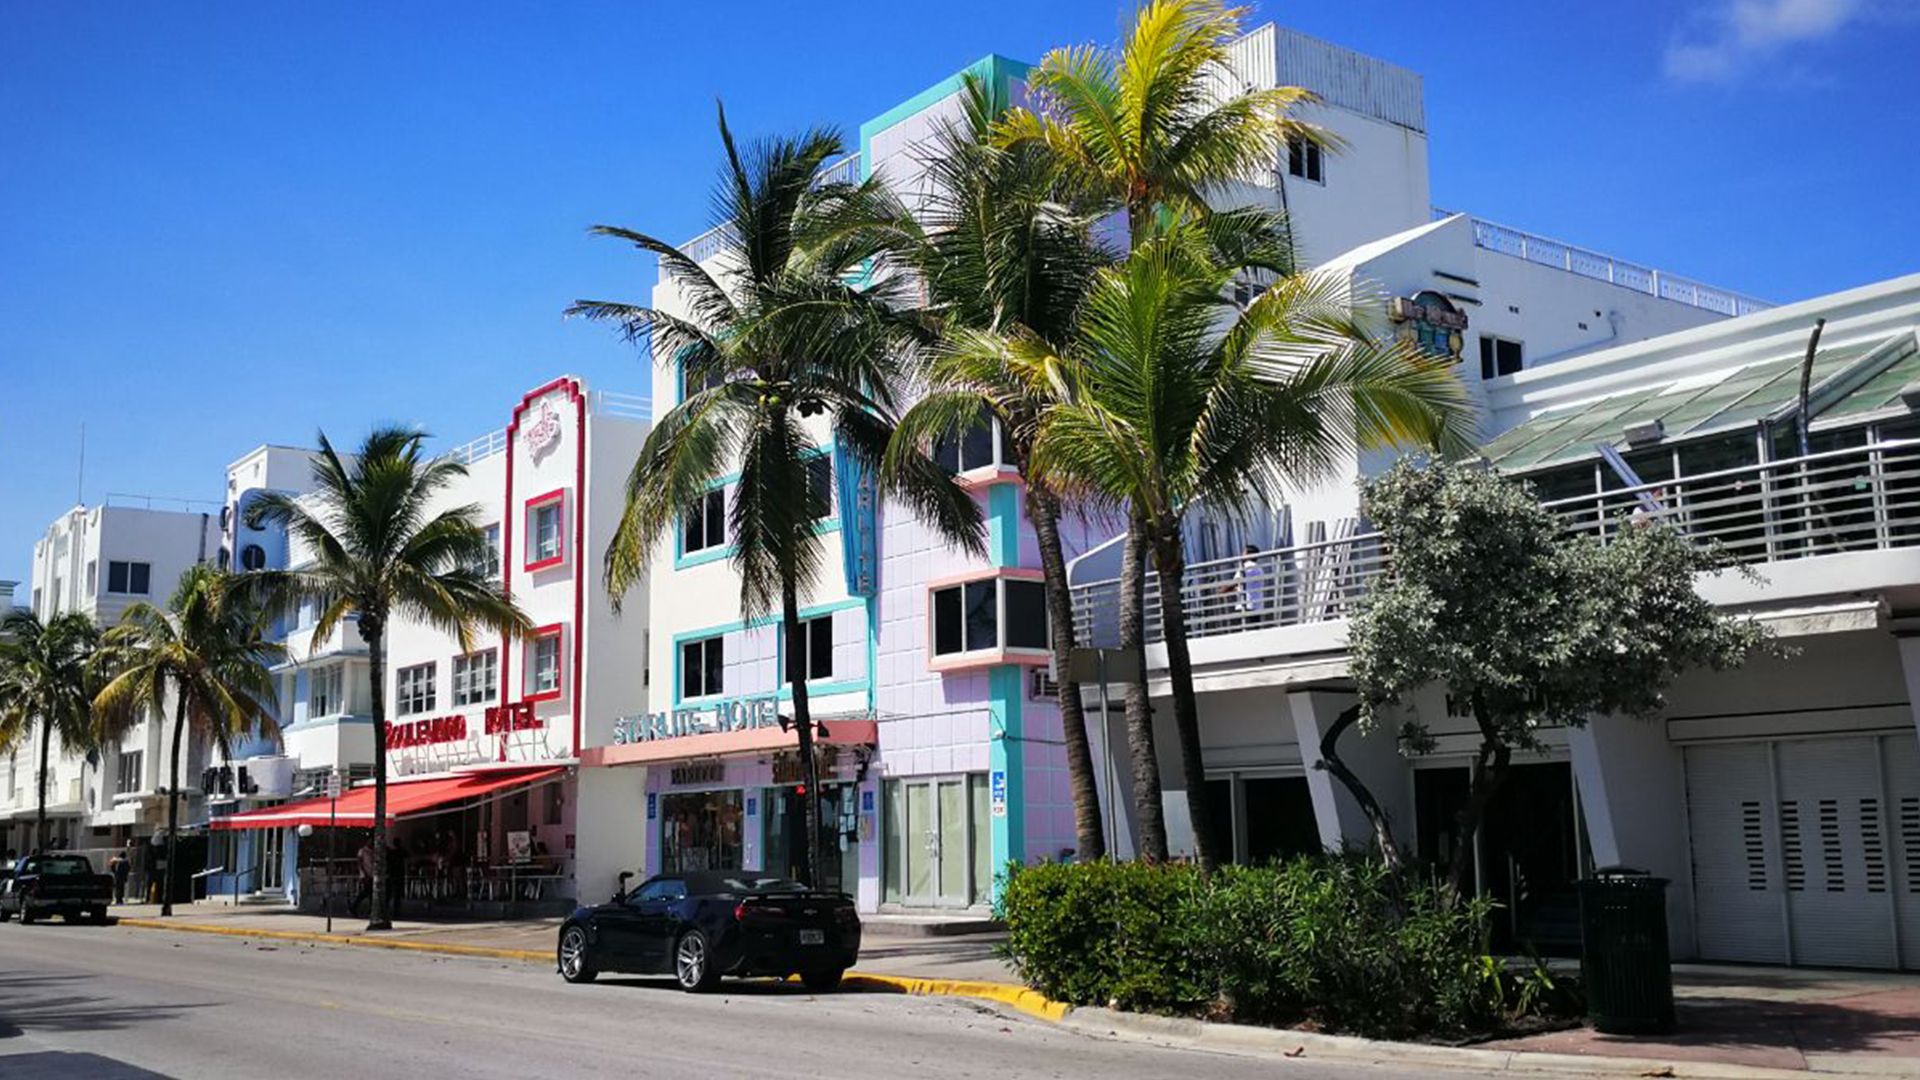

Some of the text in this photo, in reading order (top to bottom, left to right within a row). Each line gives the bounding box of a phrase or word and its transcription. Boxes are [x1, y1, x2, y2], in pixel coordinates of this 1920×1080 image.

[484, 702, 544, 735] HOTEL
[613, 697, 779, 745] STARLITE HOTEL
